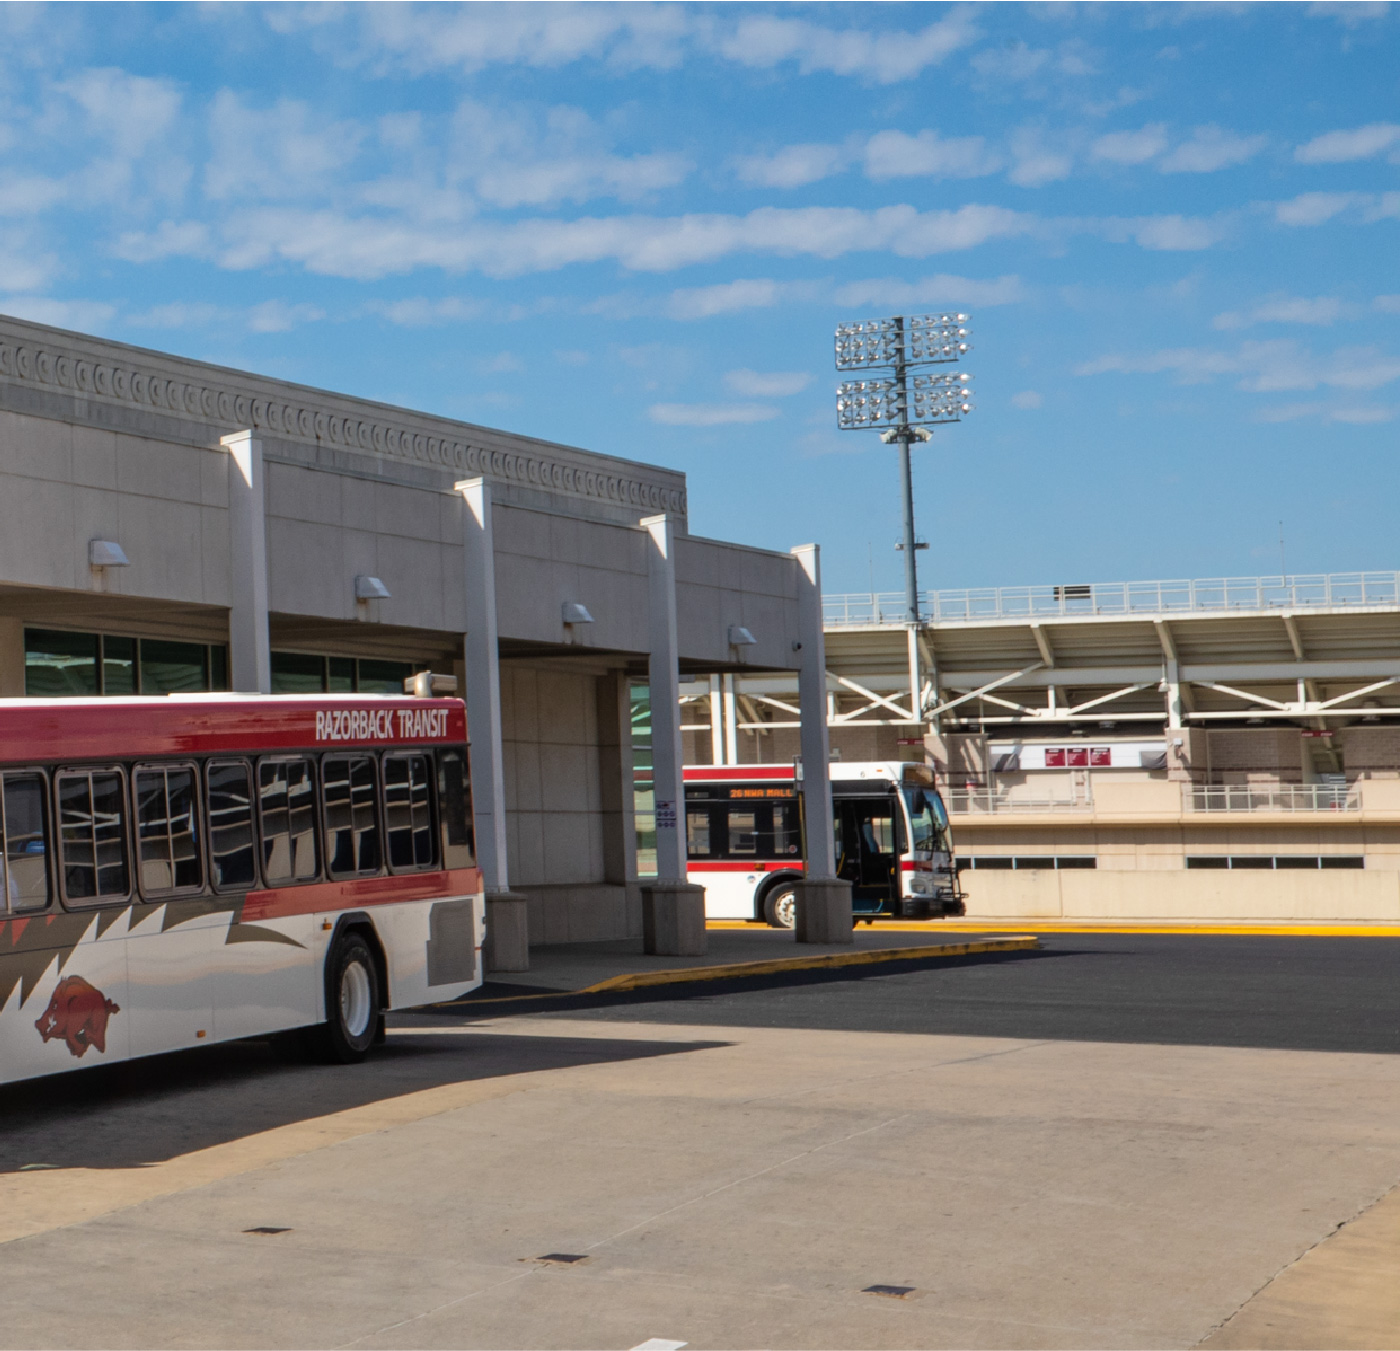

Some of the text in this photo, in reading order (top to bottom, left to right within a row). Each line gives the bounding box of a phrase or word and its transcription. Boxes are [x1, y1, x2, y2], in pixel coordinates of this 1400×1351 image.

[315, 709, 449, 740] RAZORBACK TRANSIT
[730, 789, 741, 798] 26
[766, 788, 793, 797] MALL
